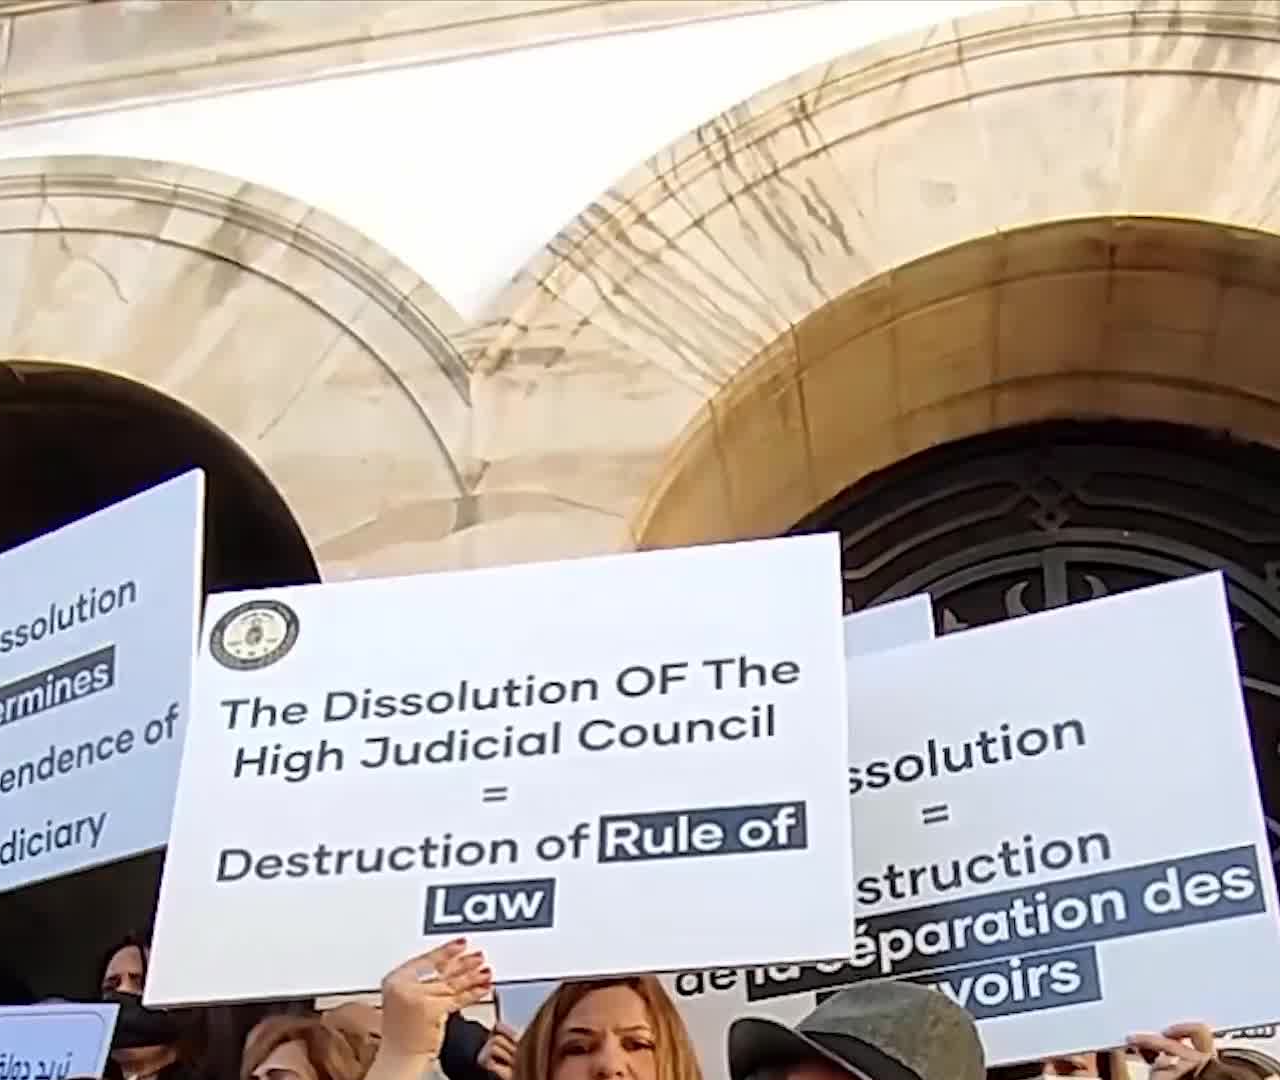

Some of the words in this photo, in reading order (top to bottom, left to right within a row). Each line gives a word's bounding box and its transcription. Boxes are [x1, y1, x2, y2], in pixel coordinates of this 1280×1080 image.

[144, 702, 179, 743] of
[221, 697, 309, 730] The
[324, 673, 599, 723] Dissolution
[617, 662, 689, 697] OF
[703, 656, 801, 690] The
[233, 738, 344, 782] High
[361, 722, 561, 769] Judicial
[578, 706, 775, 752] Council
[217, 832, 518, 882] Destruction
[536, 823, 592, 860] of
[605, 815, 723, 858] Rule
[739, 811, 798, 847] of
[857, 831, 1111, 905] struction
[432, 888, 546, 925] Law
[1144, 863, 1256, 916] des
[941, 955, 1082, 1009] voirs
